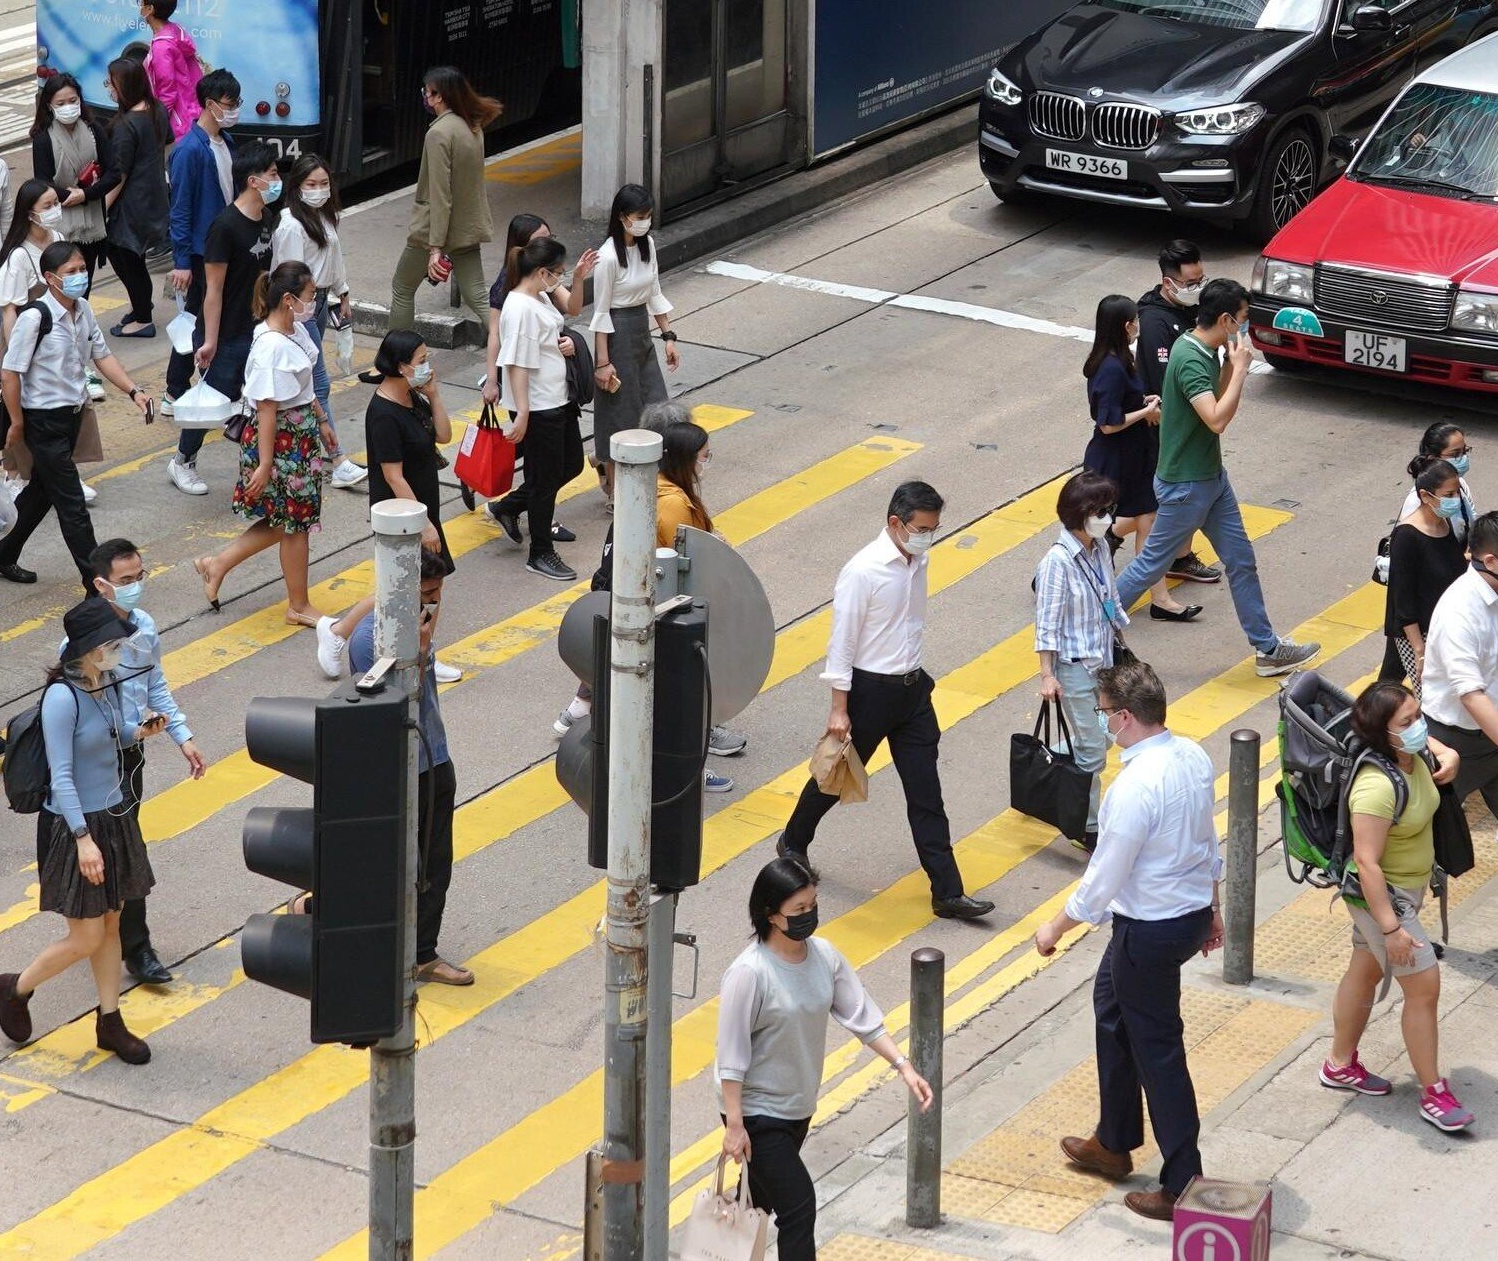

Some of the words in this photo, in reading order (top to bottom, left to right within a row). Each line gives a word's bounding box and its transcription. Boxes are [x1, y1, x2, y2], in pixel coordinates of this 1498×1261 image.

[257, 137, 303, 160] 04
[1050, 150, 1071, 169] WR
[1076, 156, 1122, 176] 9366
[1283, 323, 1313, 334] SEATS
[1292, 315, 1303, 325] 4
[1363, 333, 1388, 352] UF
[1352, 347, 1398, 370] 2194
